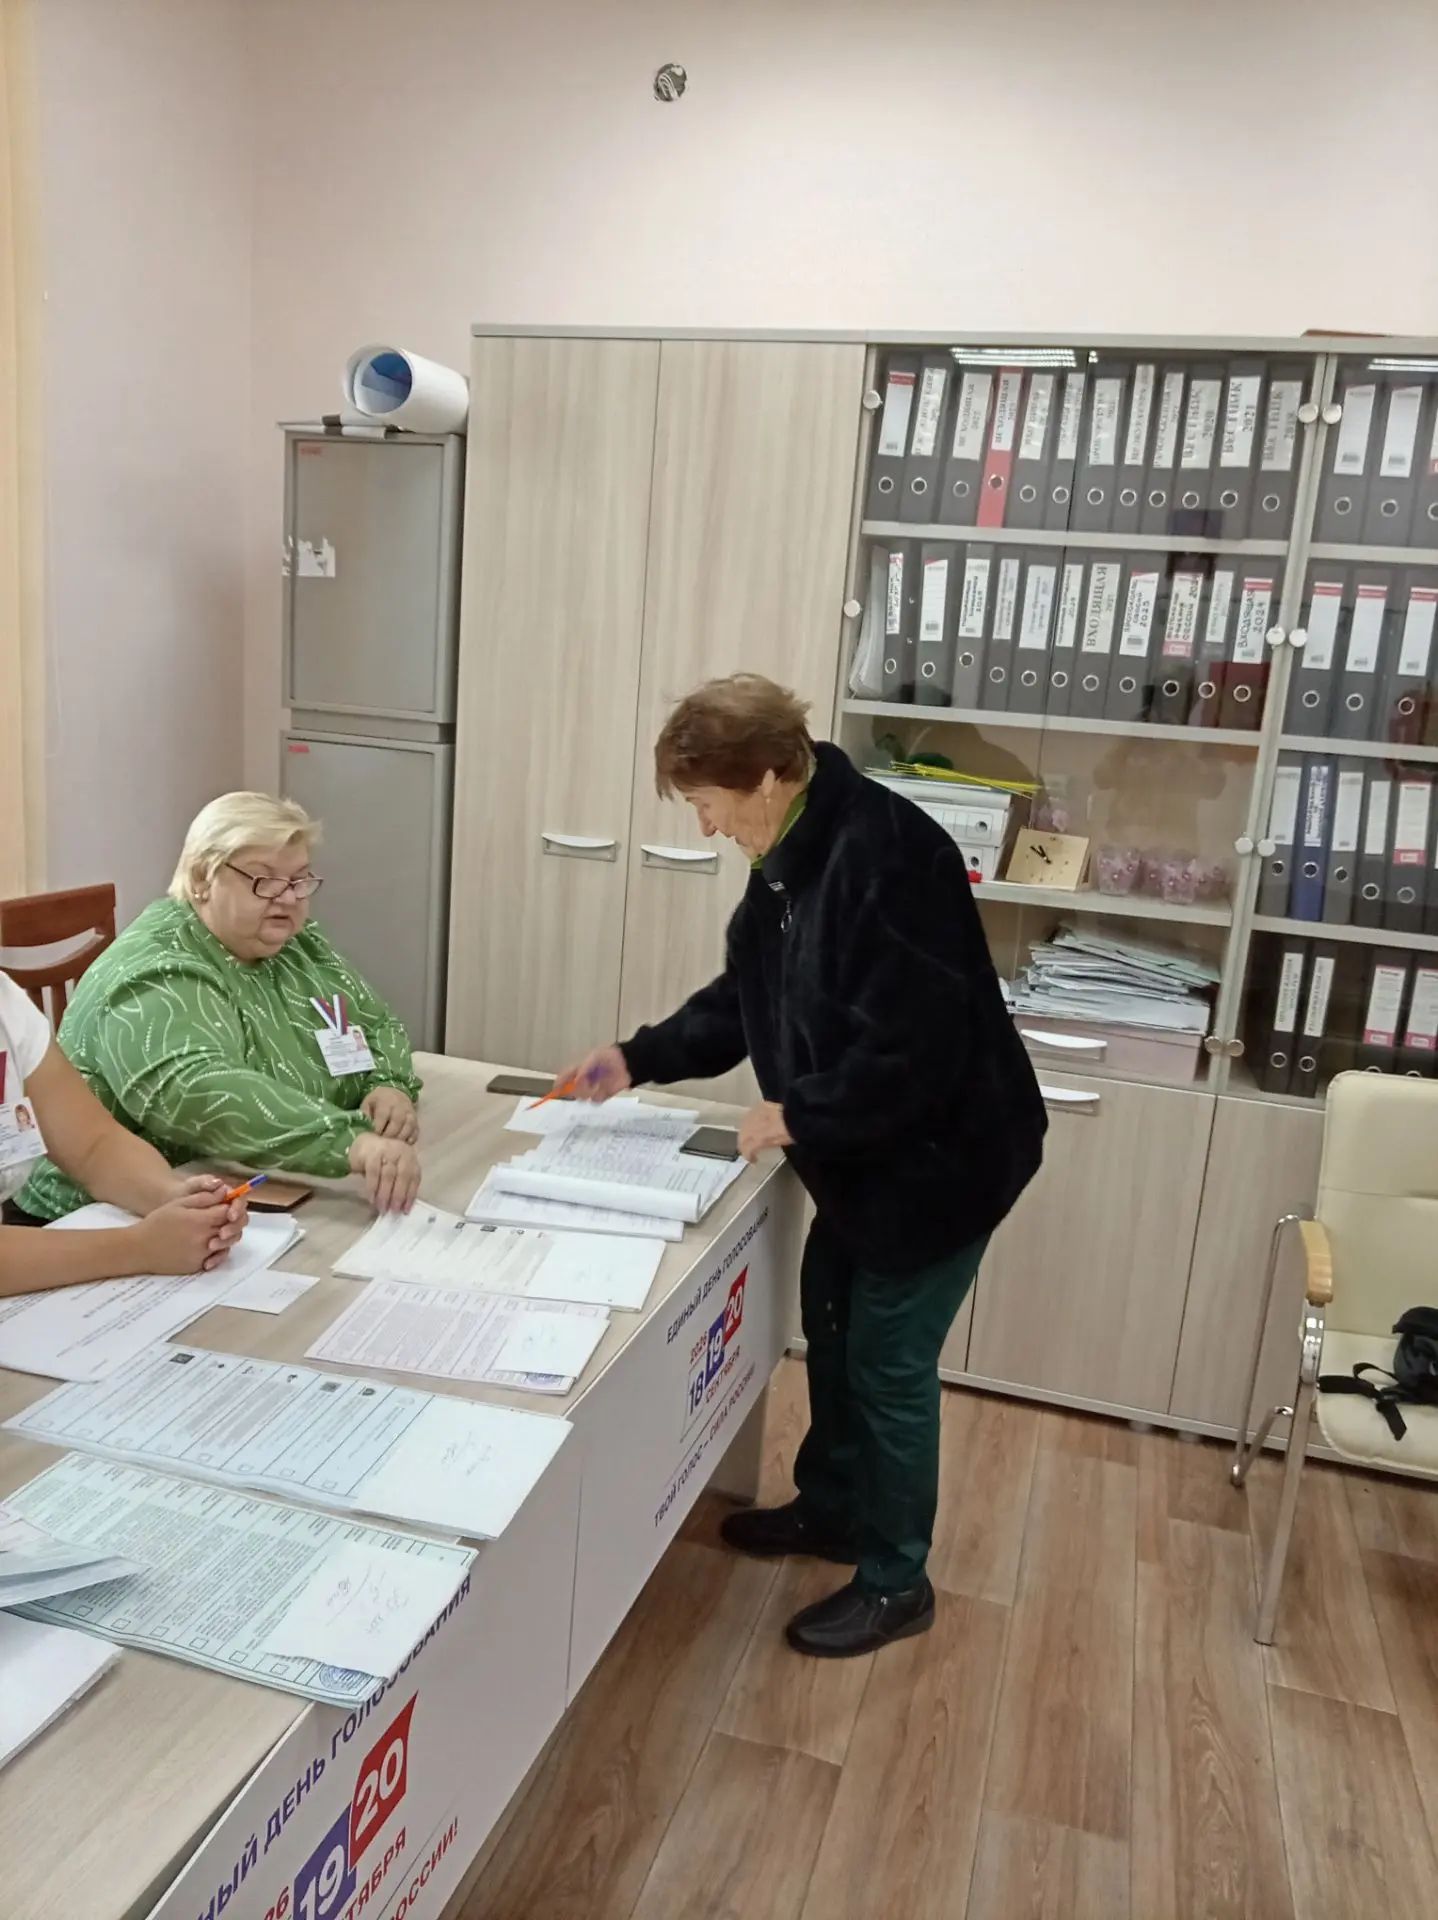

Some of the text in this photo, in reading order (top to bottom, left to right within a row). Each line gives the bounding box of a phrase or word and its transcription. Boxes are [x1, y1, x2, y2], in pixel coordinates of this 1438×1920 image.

[1086, 565, 1107, 647] ВХОДЯЩАЯ
[667, 1285, 702, 1345] ЕДИНЫЙ
[702, 1266, 721, 1302] ДЕНЬ
[689, 1285, 743, 1416] 18 19 20
[705, 1344, 741, 1403] СЕНТЯБРЯ
[654, 1483, 676, 1528] ТВОЙ
[677, 1444, 703, 1492] ГОЛОС
[263, 1757, 326, 1855] ДЕНЬ
[299, 1737, 404, 1920] 19 20
